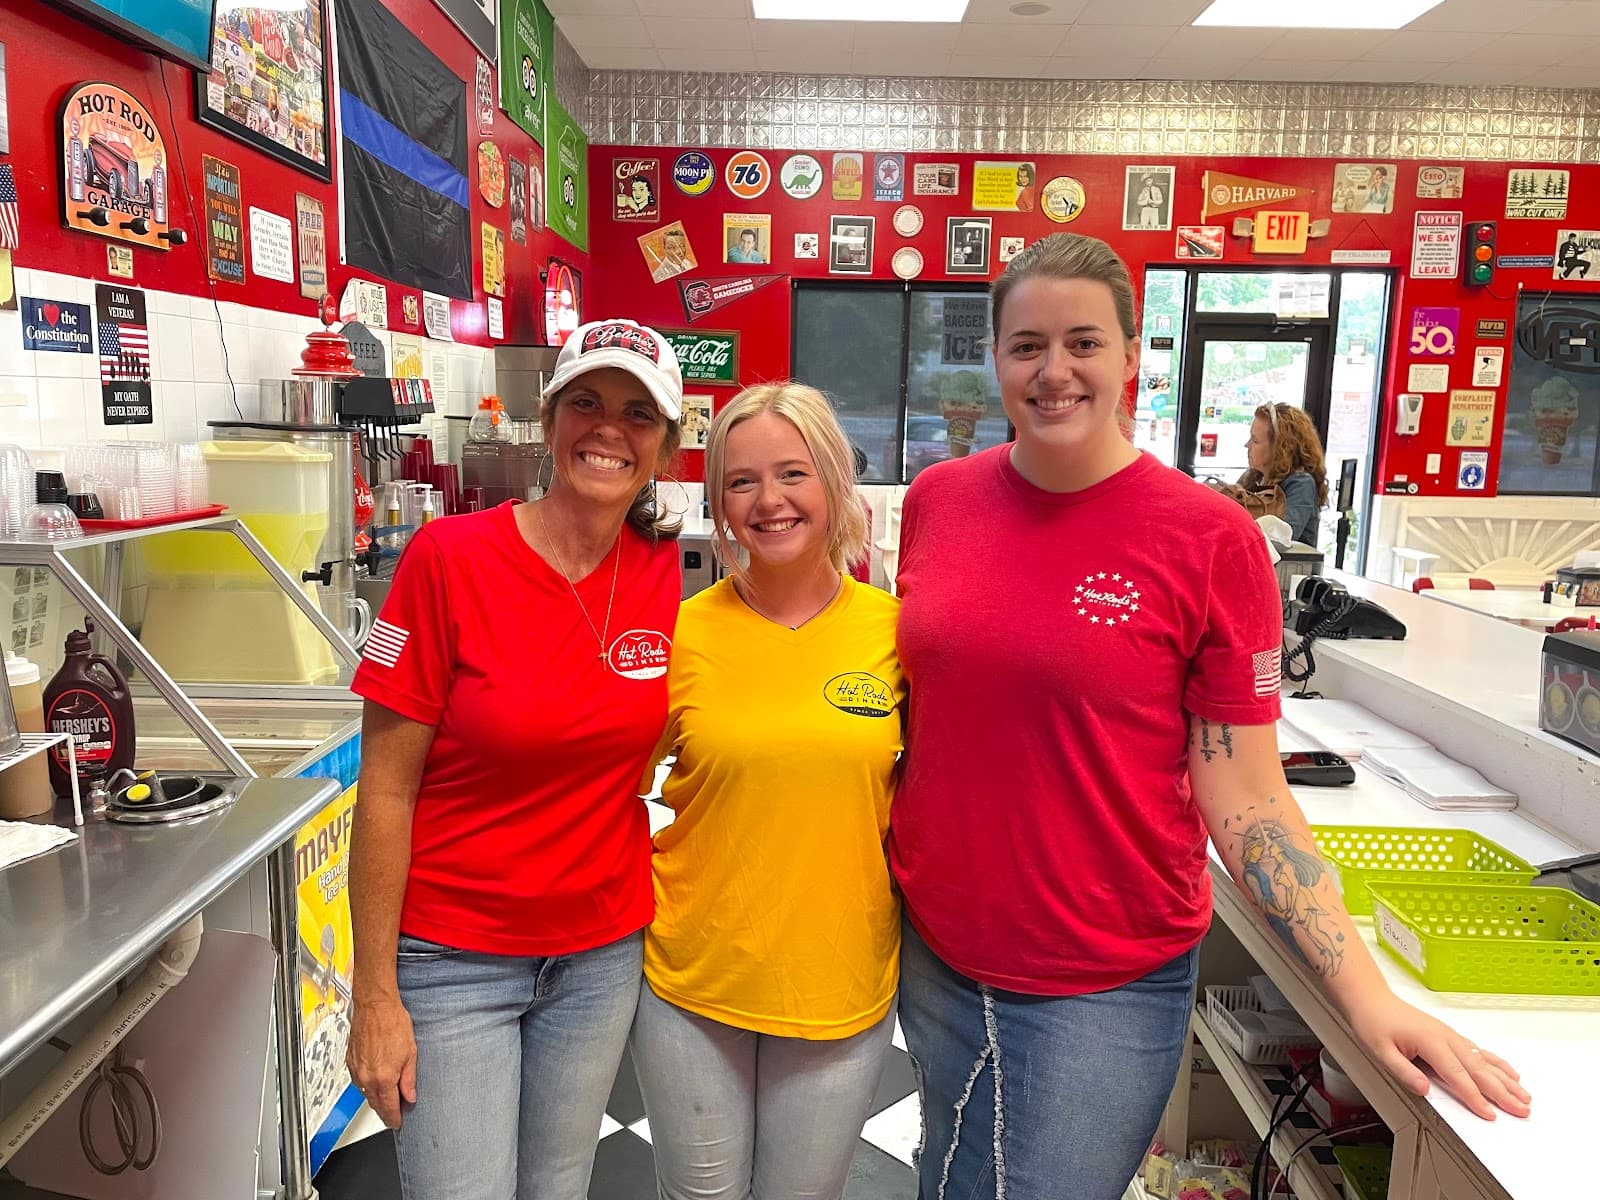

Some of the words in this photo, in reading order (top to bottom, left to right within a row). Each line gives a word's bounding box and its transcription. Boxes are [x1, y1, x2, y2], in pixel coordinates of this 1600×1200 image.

[78, 94, 115, 116] HOT
[120, 101, 155, 143] ROD
[615, 160, 656, 180] Coffee!
[674, 167, 699, 178] MOON
[700, 168, 715, 178] PIE
[733, 162, 761, 186] 76
[1423, 171, 1443, 181] Esso
[1231, 186, 1297, 203] HARVARD
[88, 191, 151, 220] GARAGE
[1506, 208, 1526, 218] WHO
[1526, 208, 1542, 218] CUT
[1543, 209, 1565, 218] ONE?
[300, 210, 322, 230] FREE
[1266, 215, 1301, 241] EXIT
[1419, 215, 1459, 226] NOTICE
[212, 219, 238, 243] WAY
[1418, 234, 1433, 242] WE
[1437, 234, 1456, 242] SAY
[301, 233, 324, 266] LUNCH
[212, 257, 243, 277] EXCUSE
[1418, 266, 1451, 274] LEAVE
[713, 283, 754, 300] GAMECOCKS
[728, 278, 753, 289] CAROLINA
[38, 307, 43, 322] I
[61, 310, 78, 326] the
[108, 306, 135, 320] VETERAN
[944, 314, 986, 328] BAGGED
[26, 325, 89, 344] Constitution
[1409, 326, 1456, 355] 50s
[114, 391, 123, 402] MY
[123, 391, 139, 402] OATH
[1454, 394, 1493, 402] COMPLAINT
[107, 406, 127, 417] NEVER
[127, 405, 149, 417] EXPIRES
[1451, 403, 1493, 411] DEPARTMENT
[1083, 588, 1102, 601] Hot
[618, 641, 638, 661] Hot
[638, 639, 667, 659] Rods
[836, 680, 860, 696] Hot
[861, 683, 888, 701] Rods
[52, 717, 110, 734] HERSHEY'S
[318, 860, 344, 893] Hand
[325, 882, 340, 906] Ice
[112, 992, 157, 1037] PRESSURE
